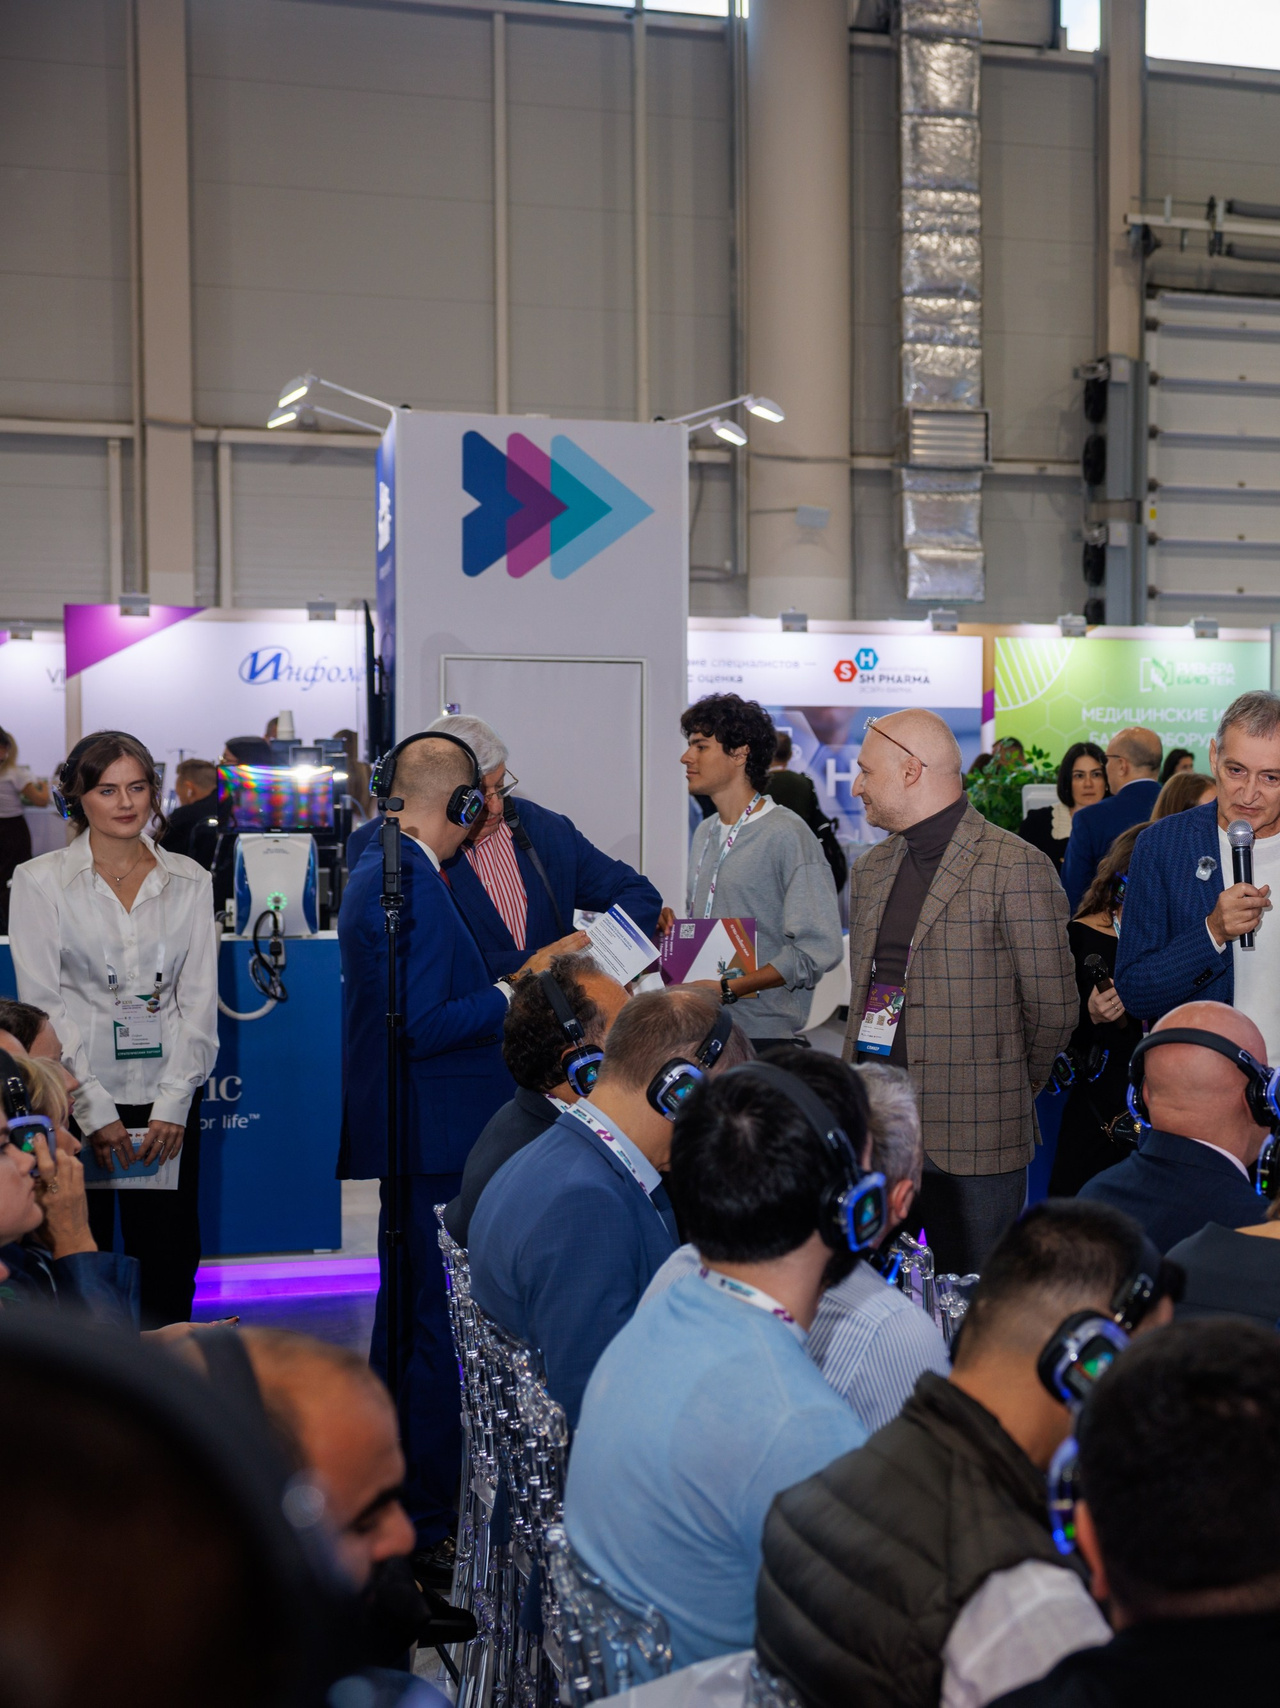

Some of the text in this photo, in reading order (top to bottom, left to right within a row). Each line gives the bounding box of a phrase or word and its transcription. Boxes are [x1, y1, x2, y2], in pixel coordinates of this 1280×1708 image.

[859, 674, 930, 684] SH PHARMA
[1082, 707, 1209, 724] МЕДИЦИНСКИЕ
[200, 1117, 217, 1130] or
